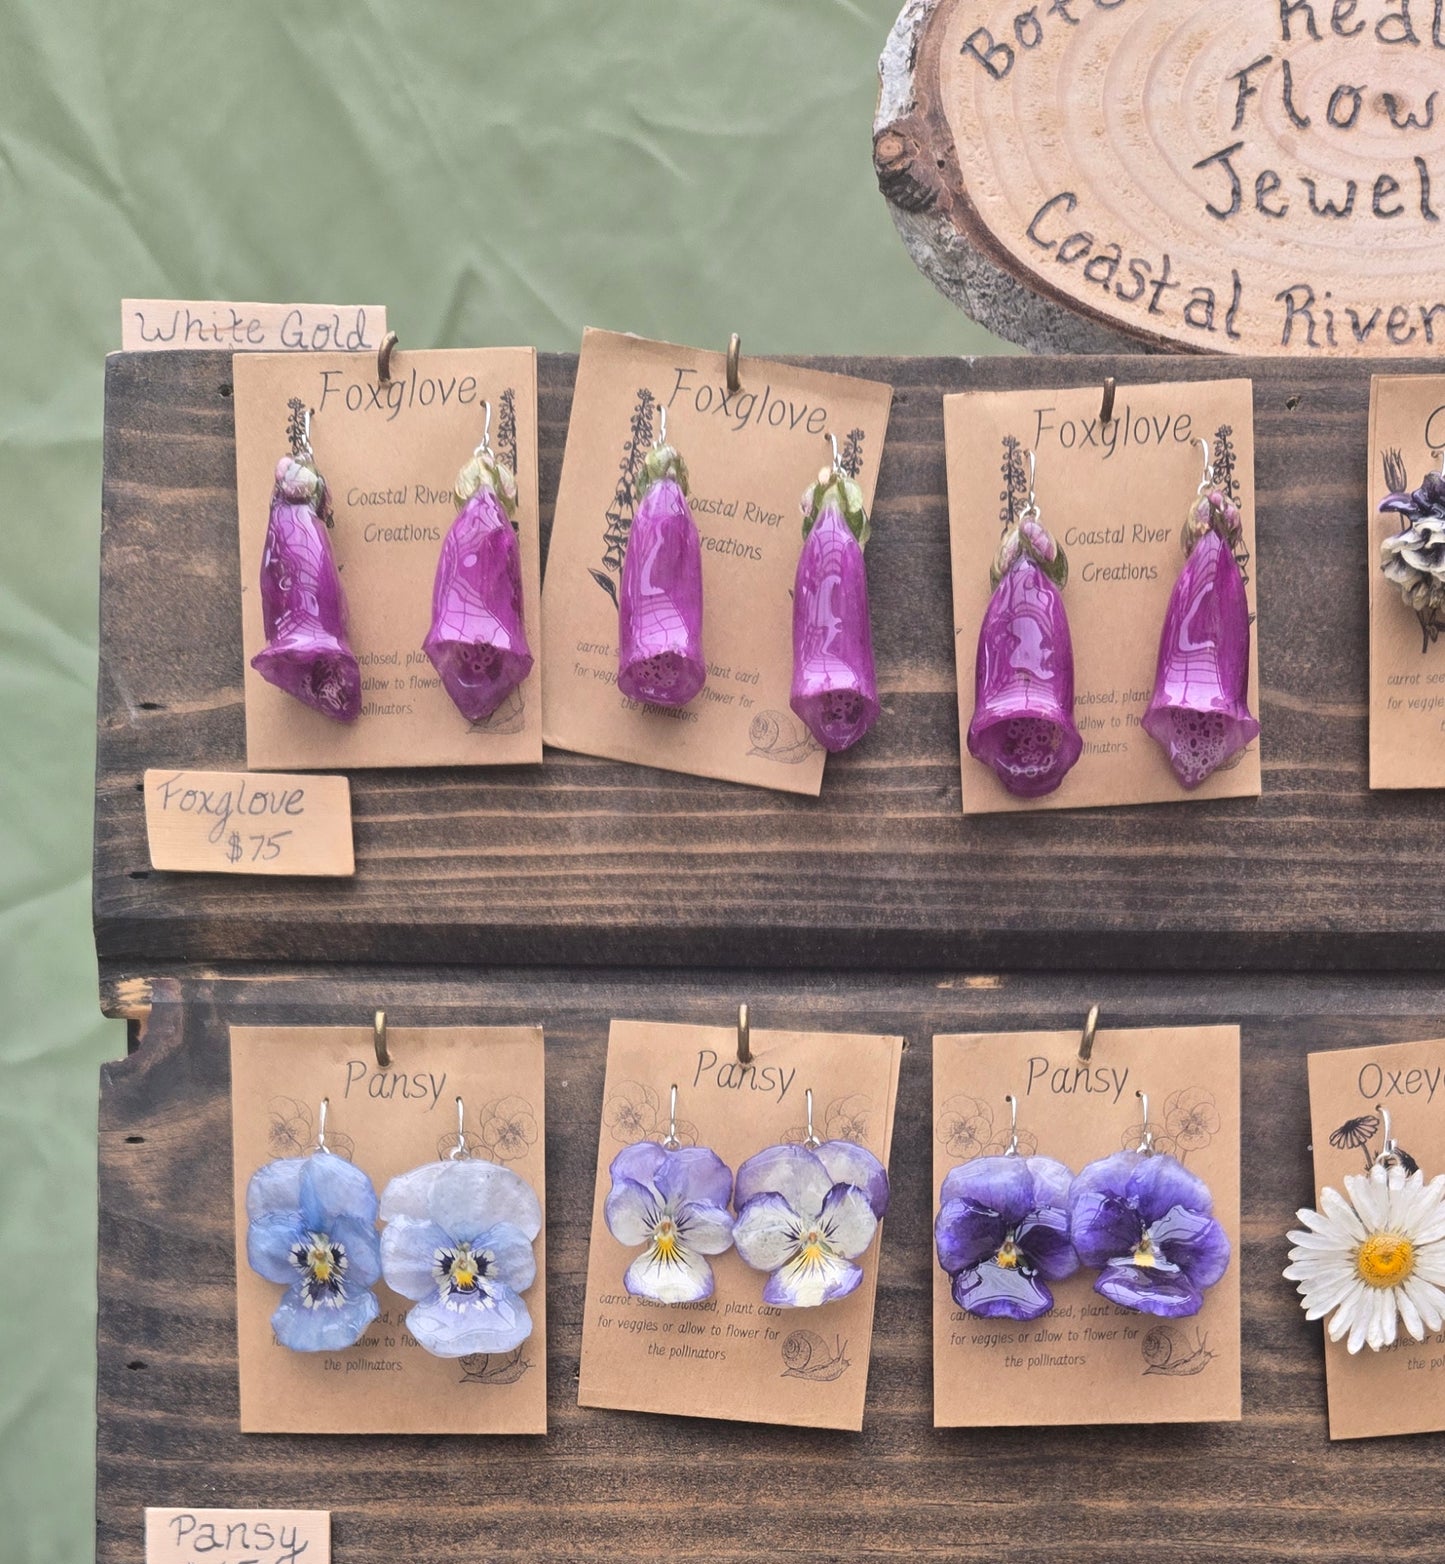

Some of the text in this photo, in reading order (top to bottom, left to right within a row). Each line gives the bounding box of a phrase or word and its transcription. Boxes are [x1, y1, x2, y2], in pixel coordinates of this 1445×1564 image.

[960, 0, 1125, 80] Bot
[1025, 191, 1241, 340] Coastal
[135, 309, 372, 350] White Gold
[319, 368, 477, 421] Foxglove
[668, 368, 827, 434] Foxglove
[1033, 406, 1191, 459] Foxglove
[347, 486, 407, 506] Coastal
[688, 497, 784, 528] oastal River
[364, 523, 440, 542] Creations
[1065, 525, 1172, 545] Coastal River
[700, 531, 762, 560] reations
[1082, 563, 1158, 581] Creations
[577, 640, 609, 656] carrot
[574, 663, 589, 676] for
[735, 670, 759, 684] card
[1387, 674, 1420, 684] carrot
[395, 679, 404, 688] to
[621, 698, 638, 710] the
[701, 688, 754, 708] flower for
[1387, 696, 1402, 709] for
[1078, 716, 1120, 730] allow to
[157, 773, 304, 843] Foxglove
[226, 831, 293, 863] $75
[693, 1050, 795, 1103] Pansy
[1027, 1057, 1128, 1104] Pansy
[345, 1061, 446, 1113] Pansy
[600, 1293, 631, 1306] carrot
[724, 1302, 753, 1316] plant
[1081, 1305, 1109, 1319] plant
[598, 1316, 780, 1340] for veggies or allow to flower for
[950, 1328, 1138, 1347] for veggies or allow to flower for
[384, 1337, 395, 1347] to
[648, 1343, 726, 1361] the pollinators
[324, 1360, 402, 1374] the pollinators
[1005, 1355, 1085, 1369] the pollinators
[1408, 1358, 1425, 1370] the
